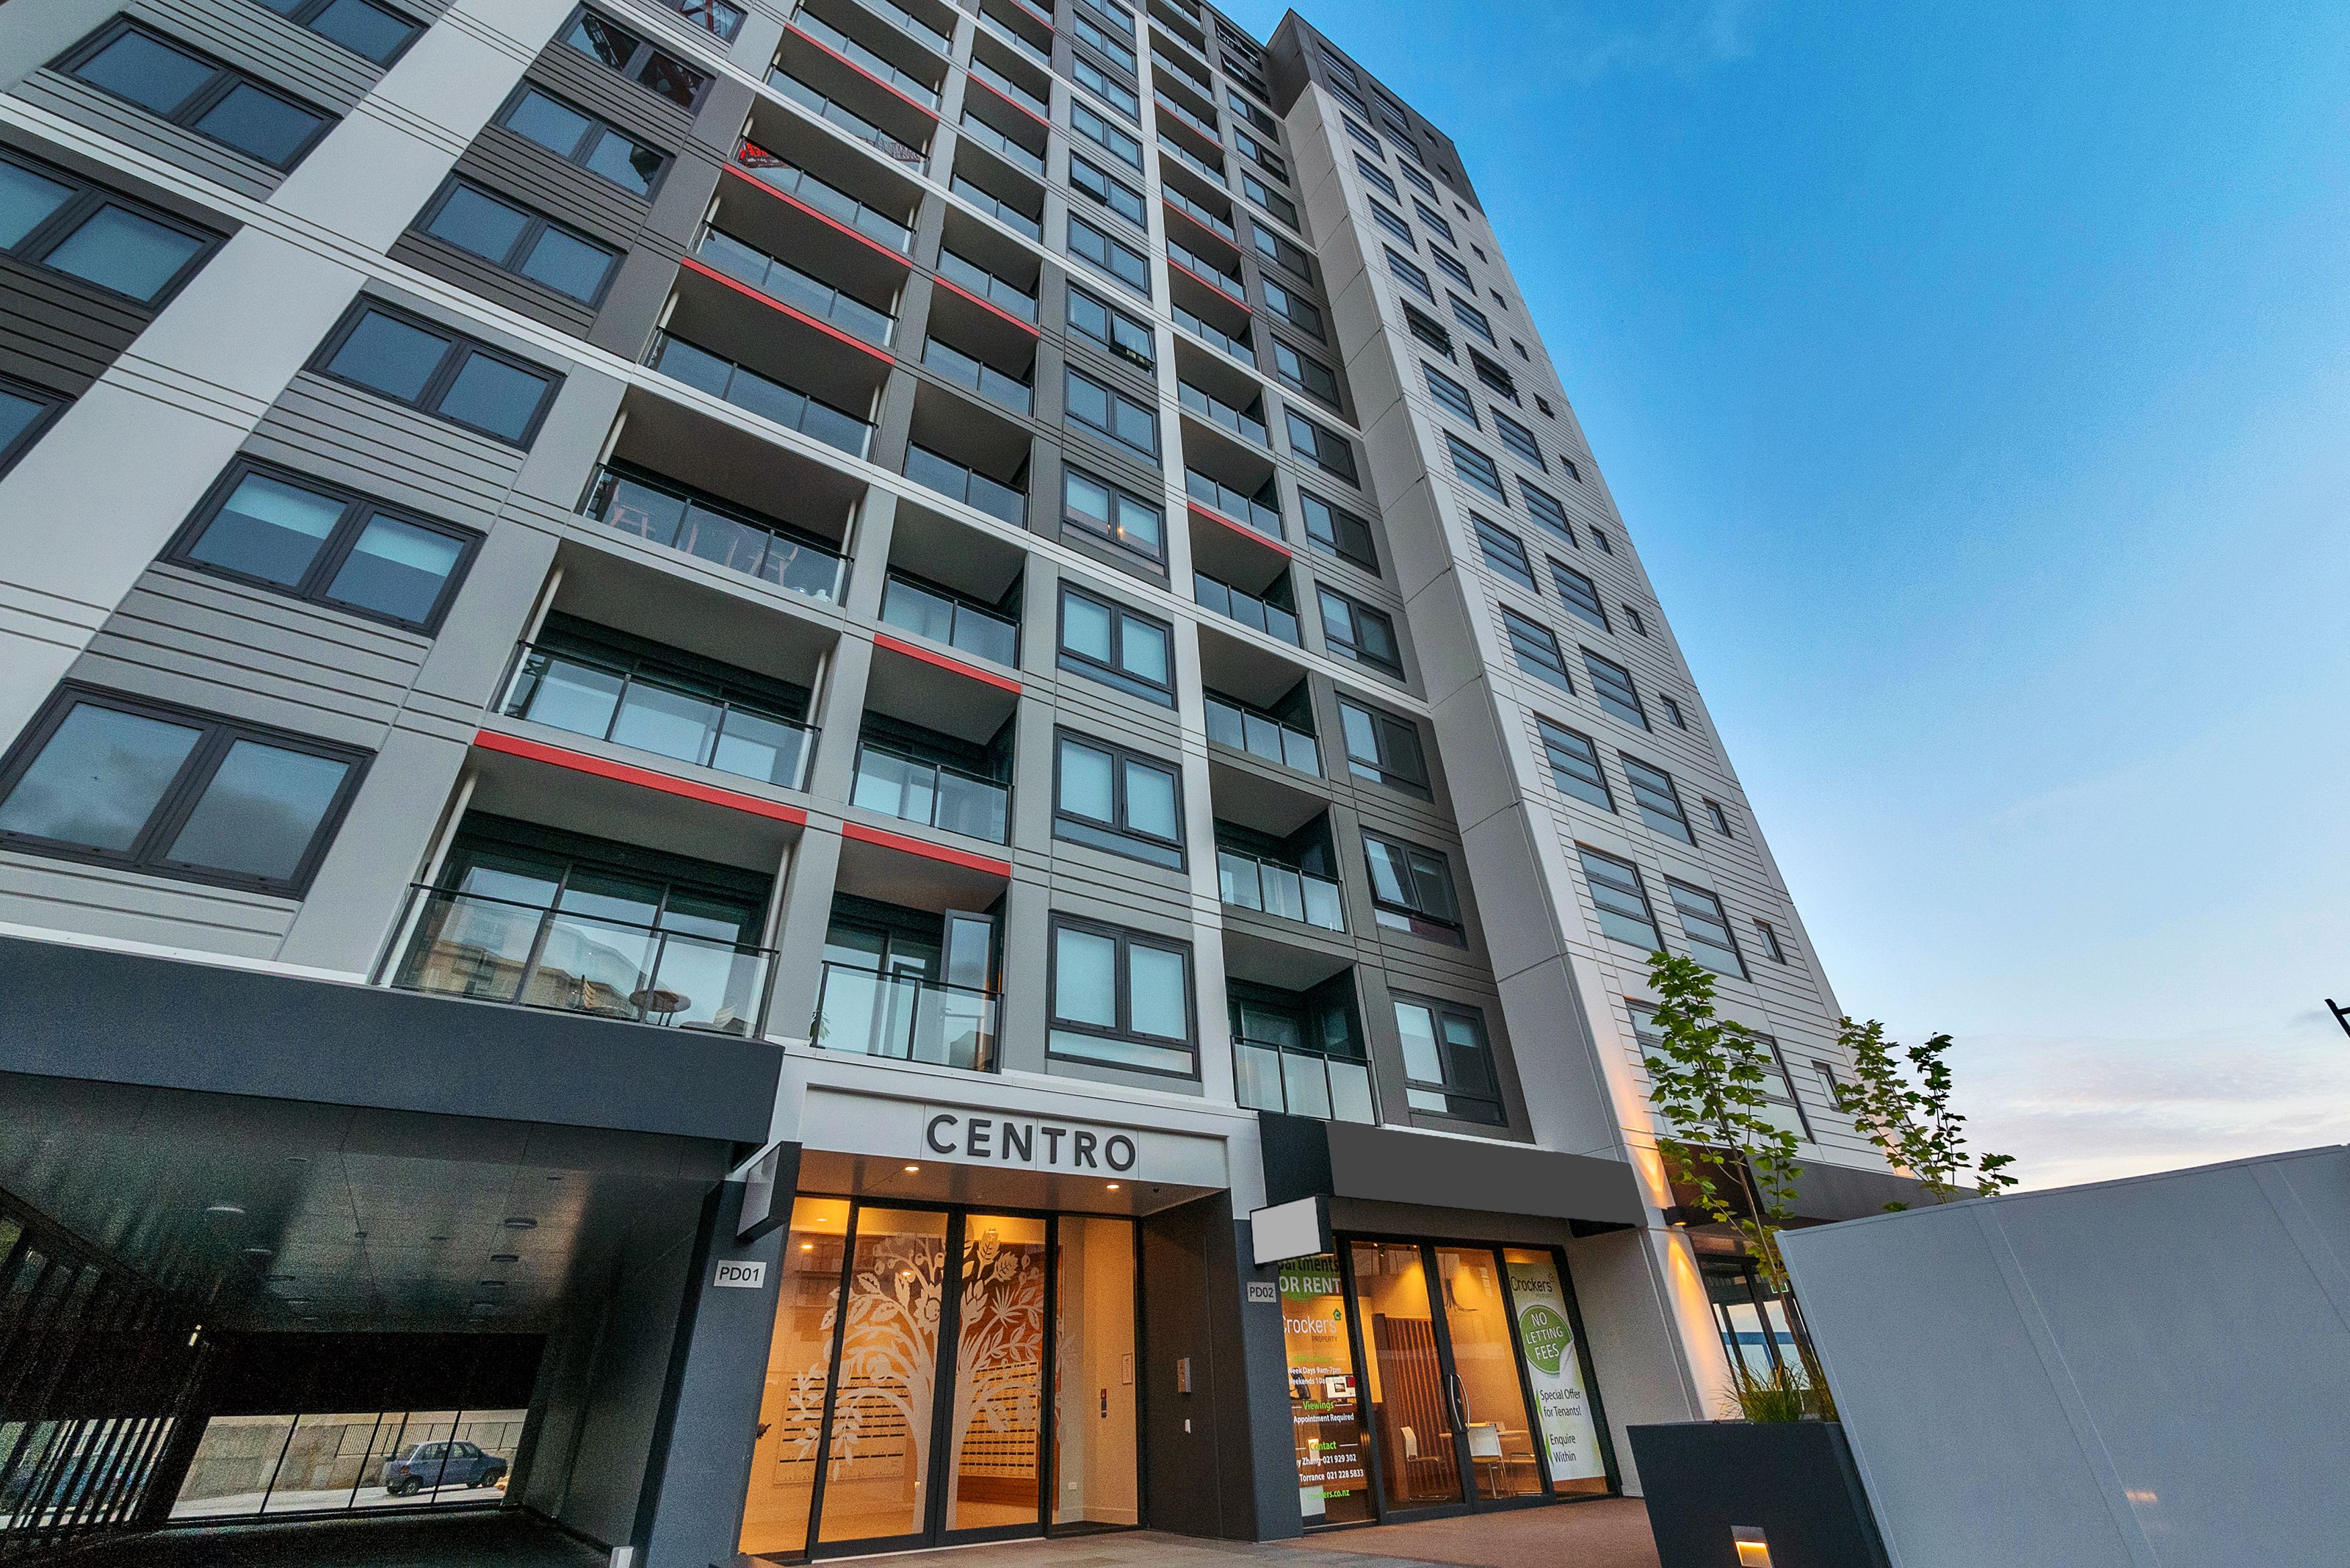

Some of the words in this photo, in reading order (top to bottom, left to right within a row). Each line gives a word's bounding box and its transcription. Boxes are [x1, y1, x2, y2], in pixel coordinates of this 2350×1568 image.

[927, 1114, 1136, 1171] CENTRO
[719, 1266, 759, 1282] PD01
[1303, 1276, 1341, 1293] RENT
[1510, 1276, 1553, 1293] Crockers
[1250, 1287, 1274, 1298] PD02
[1531, 1312, 1547, 1327] NO
[1525, 1326, 1563, 1345] LETTING
[1534, 1343, 1560, 1361] FEES
[1303, 1367, 1316, 1375] Days
[1317, 1367, 1341, 1375] 9am-7pm
[1540, 1390, 1563, 1402] Special
[1564, 1388, 1581, 1399] Offer
[1303, 1401, 1334, 1411] Viewings
[1544, 1406, 1553, 1417] for
[1553, 1405, 1582, 1417] Tenants!
[1293, 1415, 1330, 1425] Appointment
[1330, 1412, 1354, 1423] Required
[1309, 1441, 1337, 1450] Contact
[1550, 1434, 1576, 1447] Enquire
[1302, 1457, 1321, 1467] Zhang
[1323, 1456, 1333, 1464] 021
[1334, 1455, 1345, 1463] 929
[1346, 1453, 1356, 1462] 302
[1552, 1451, 1577, 1462] Within
[1299, 1473, 1325, 1482] Torrance
[1326, 1471, 1337, 1480] 021
[1338, 1470, 1349, 1478] 228
[1350, 1469, 1364, 1478] 5833
